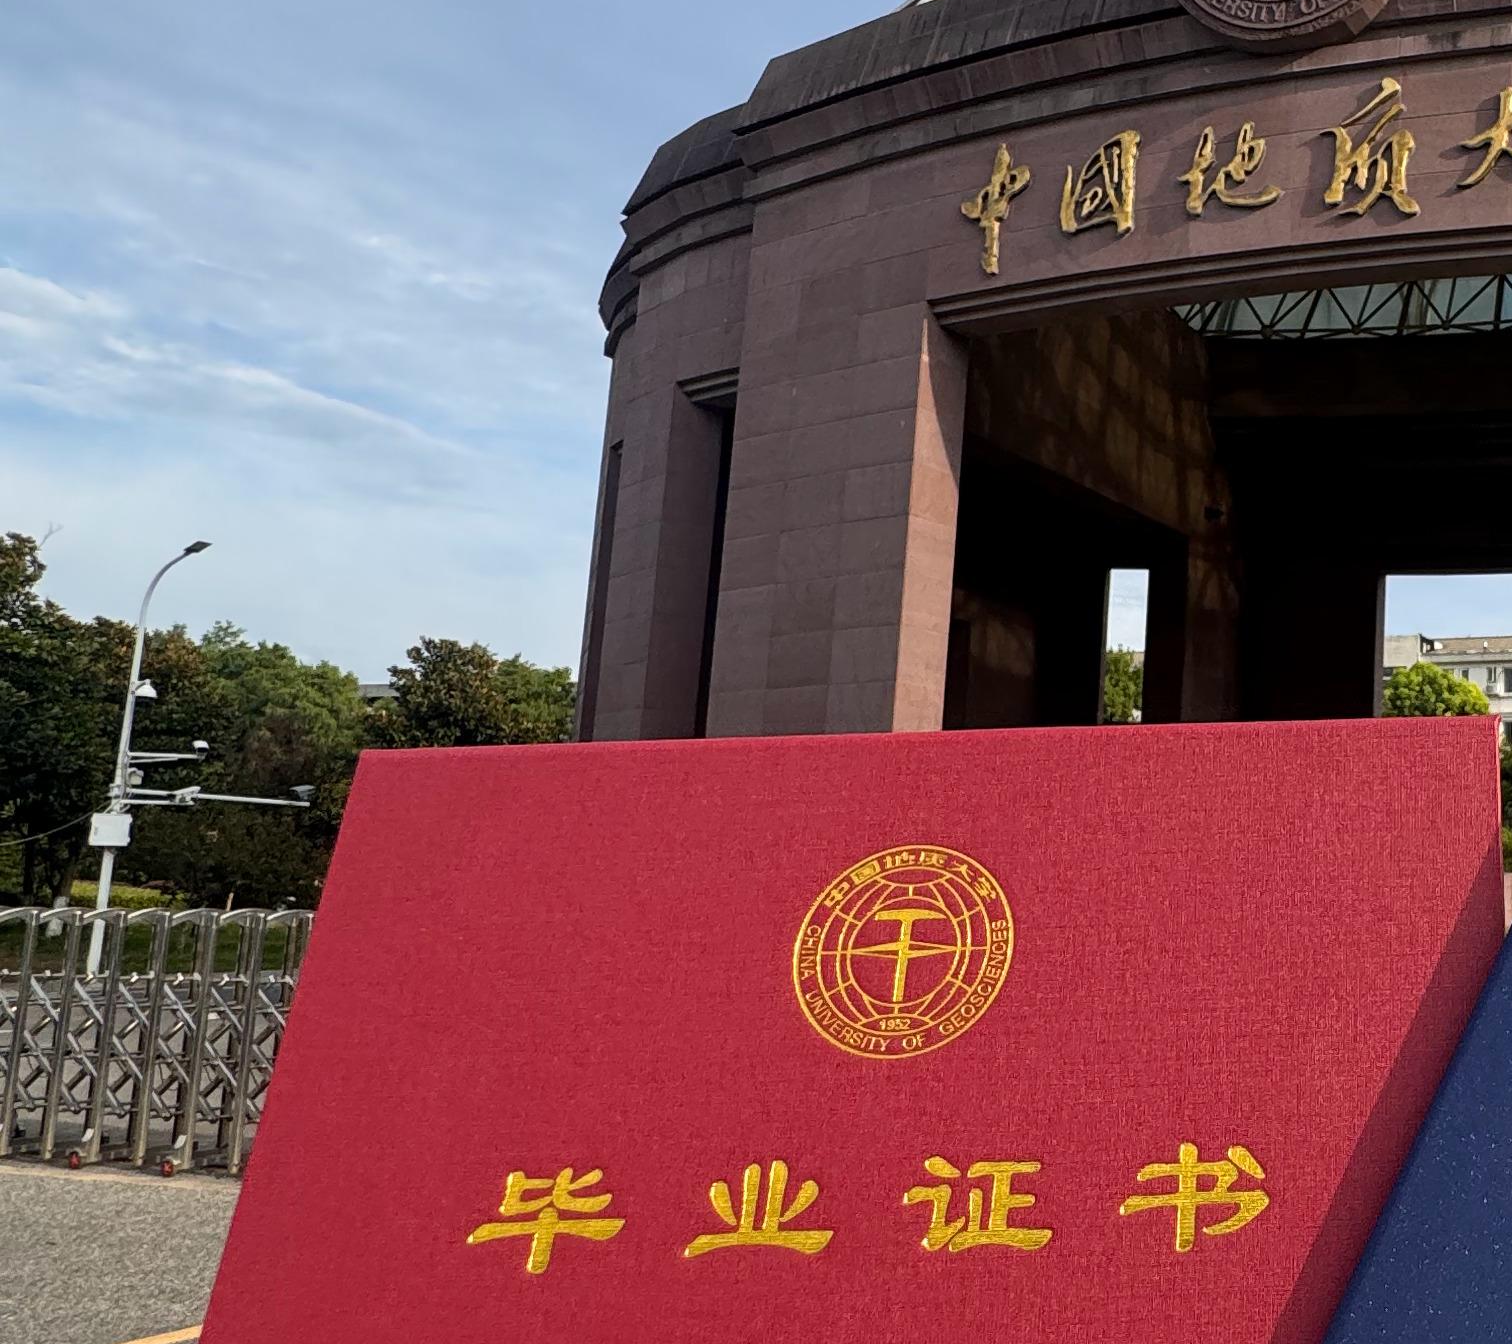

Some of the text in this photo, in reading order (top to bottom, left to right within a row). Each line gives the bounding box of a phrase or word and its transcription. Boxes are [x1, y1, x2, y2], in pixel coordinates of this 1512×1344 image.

[823, 850, 997, 908] 中国地质大学
[800, 919, 1008, 1052] CHINA UNIVERSITY OF GEOSCIENCES
[879, 1018, 911, 1031] 1952
[467, 1141, 1271, 1274] 毕业证书
